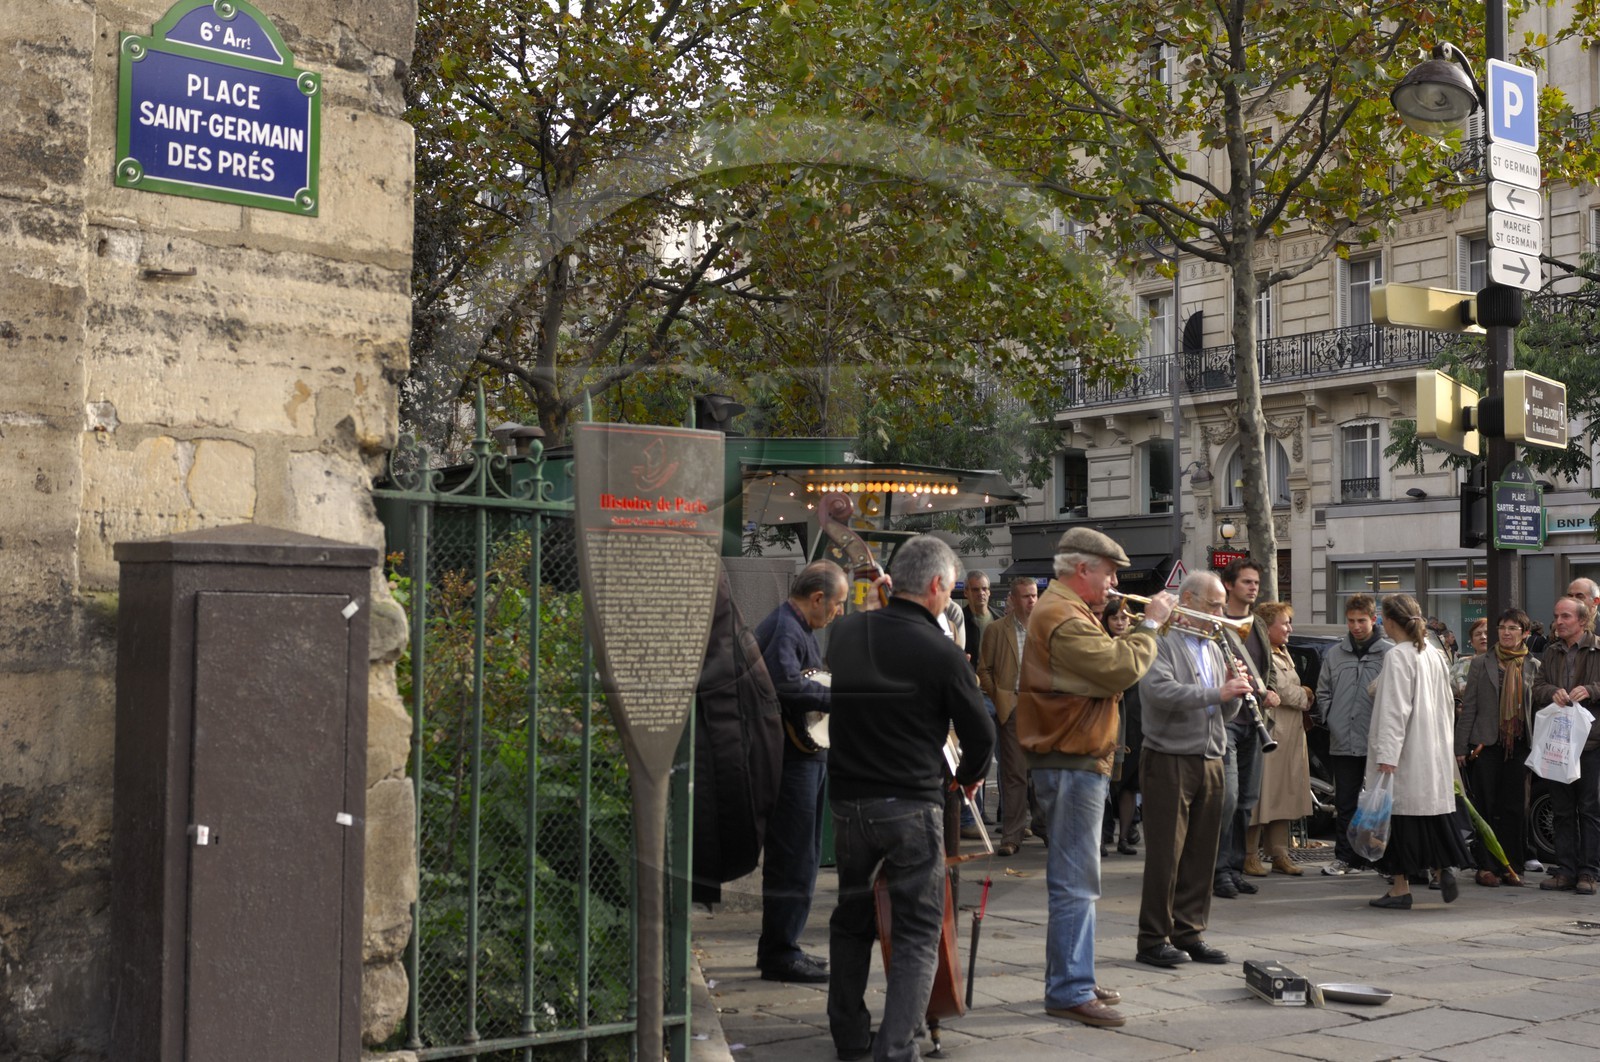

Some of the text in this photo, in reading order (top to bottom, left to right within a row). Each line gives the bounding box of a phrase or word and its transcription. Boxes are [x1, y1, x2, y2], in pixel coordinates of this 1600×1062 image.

[187, 73, 260, 110] PLACE
[1504, 80, 1524, 128] P
[139, 101, 304, 152] SAINT-GERMAIN
[168, 142, 276, 182] DES PRÉS
[1493, 156, 1538, 178] ST GERMAIN
[1504, 220, 1531, 235] MARCHÉ
[1496, 232, 1538, 250] ST GERMAIN
[600, 494, 708, 514] Histoire de Paris
[1512, 493, 1526, 502] PLACE
[1496, 504, 1514, 512] SARTRE
[1557, 518, 1585, 528] BNP
[1468, 598, 1486, 606] Banqu
